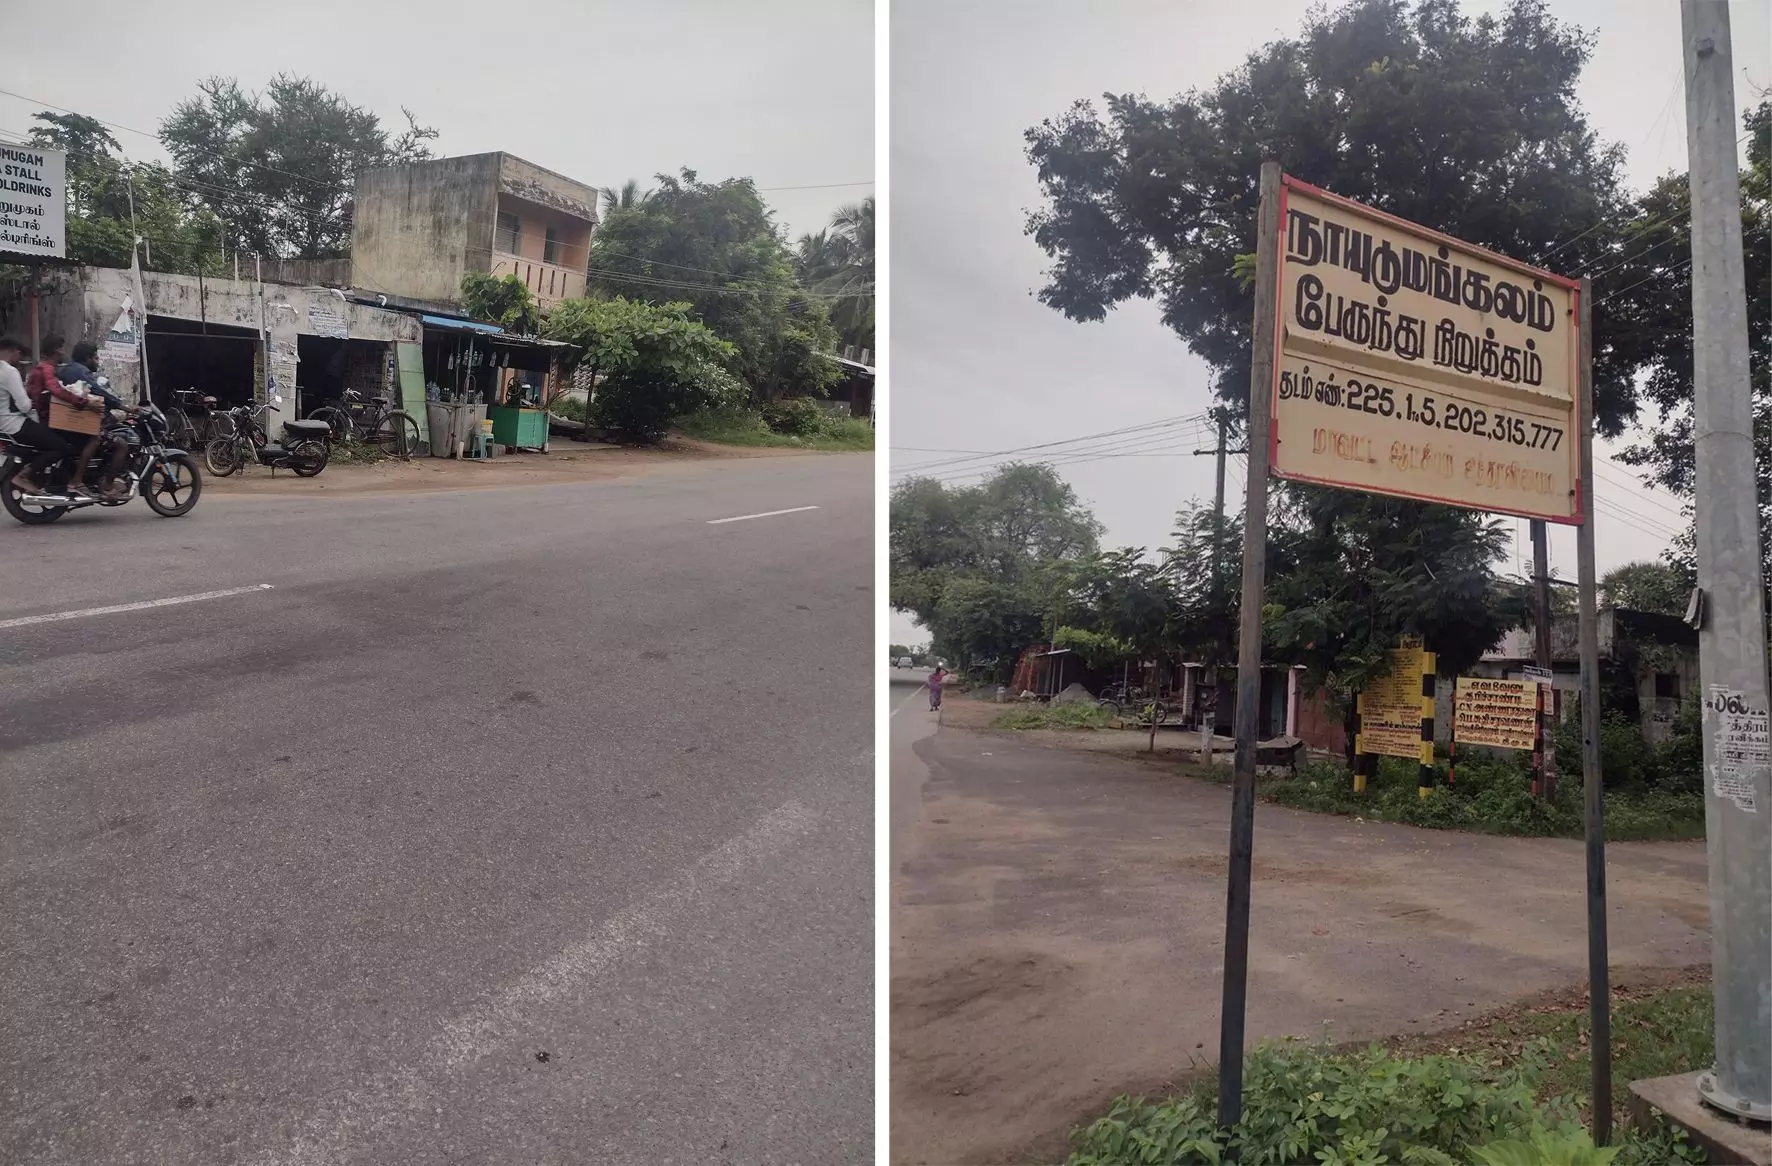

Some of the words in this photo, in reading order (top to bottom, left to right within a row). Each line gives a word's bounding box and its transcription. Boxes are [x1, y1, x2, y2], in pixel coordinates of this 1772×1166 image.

[0, 147, 44, 167] MUGAM
[4, 164, 42, 182] STALL
[1285, 207, 1555, 332] நாயுடுமங்கலம்
[1295, 273, 1426, 361] பேருந்து
[1432, 317, 1543, 387] நிறுத்தம்
